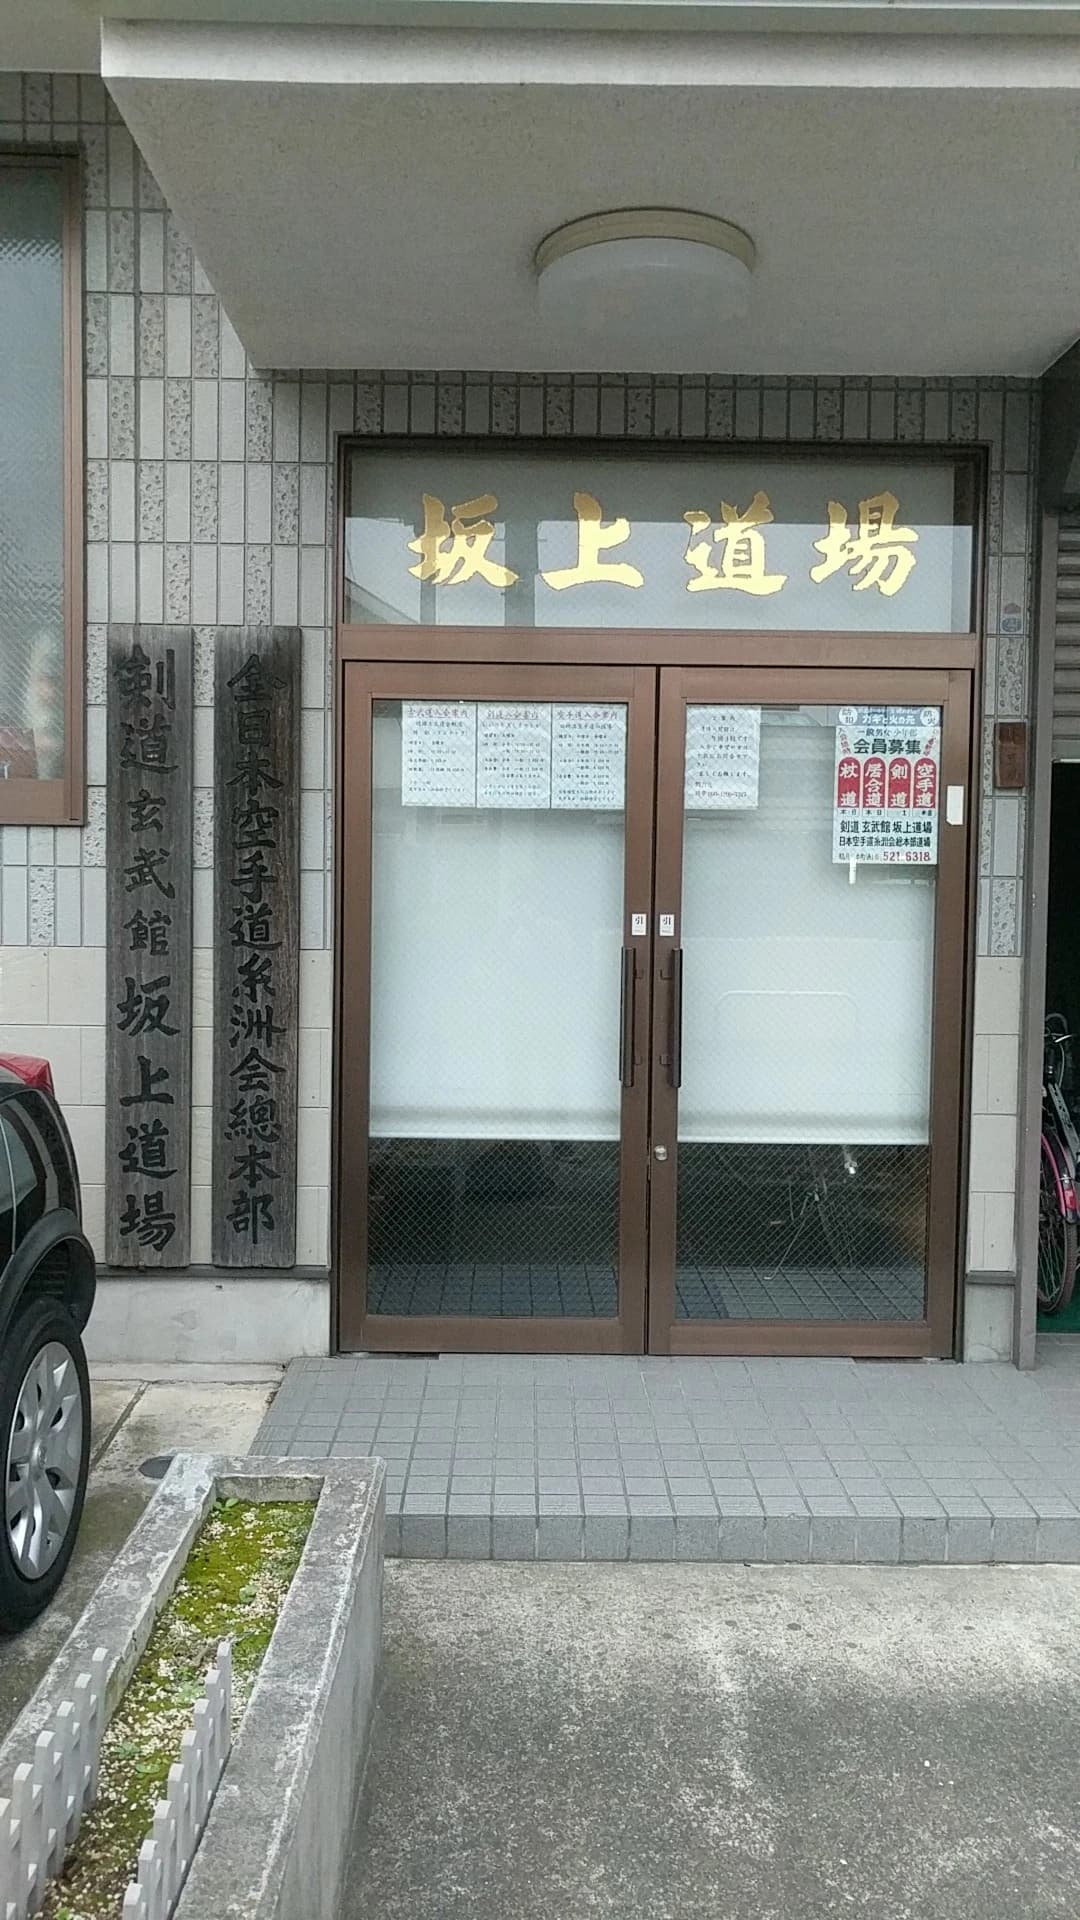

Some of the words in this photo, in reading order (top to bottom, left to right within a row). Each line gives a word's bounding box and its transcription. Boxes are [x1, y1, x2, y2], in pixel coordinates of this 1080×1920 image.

[407, 491, 919, 597] 坂上道場
[853, 738, 922, 755] 会員募集
[864, 763, 884, 807] 居合道
[915, 763, 936, 808] 空手道
[892, 820, 933, 834] 坂上道場
